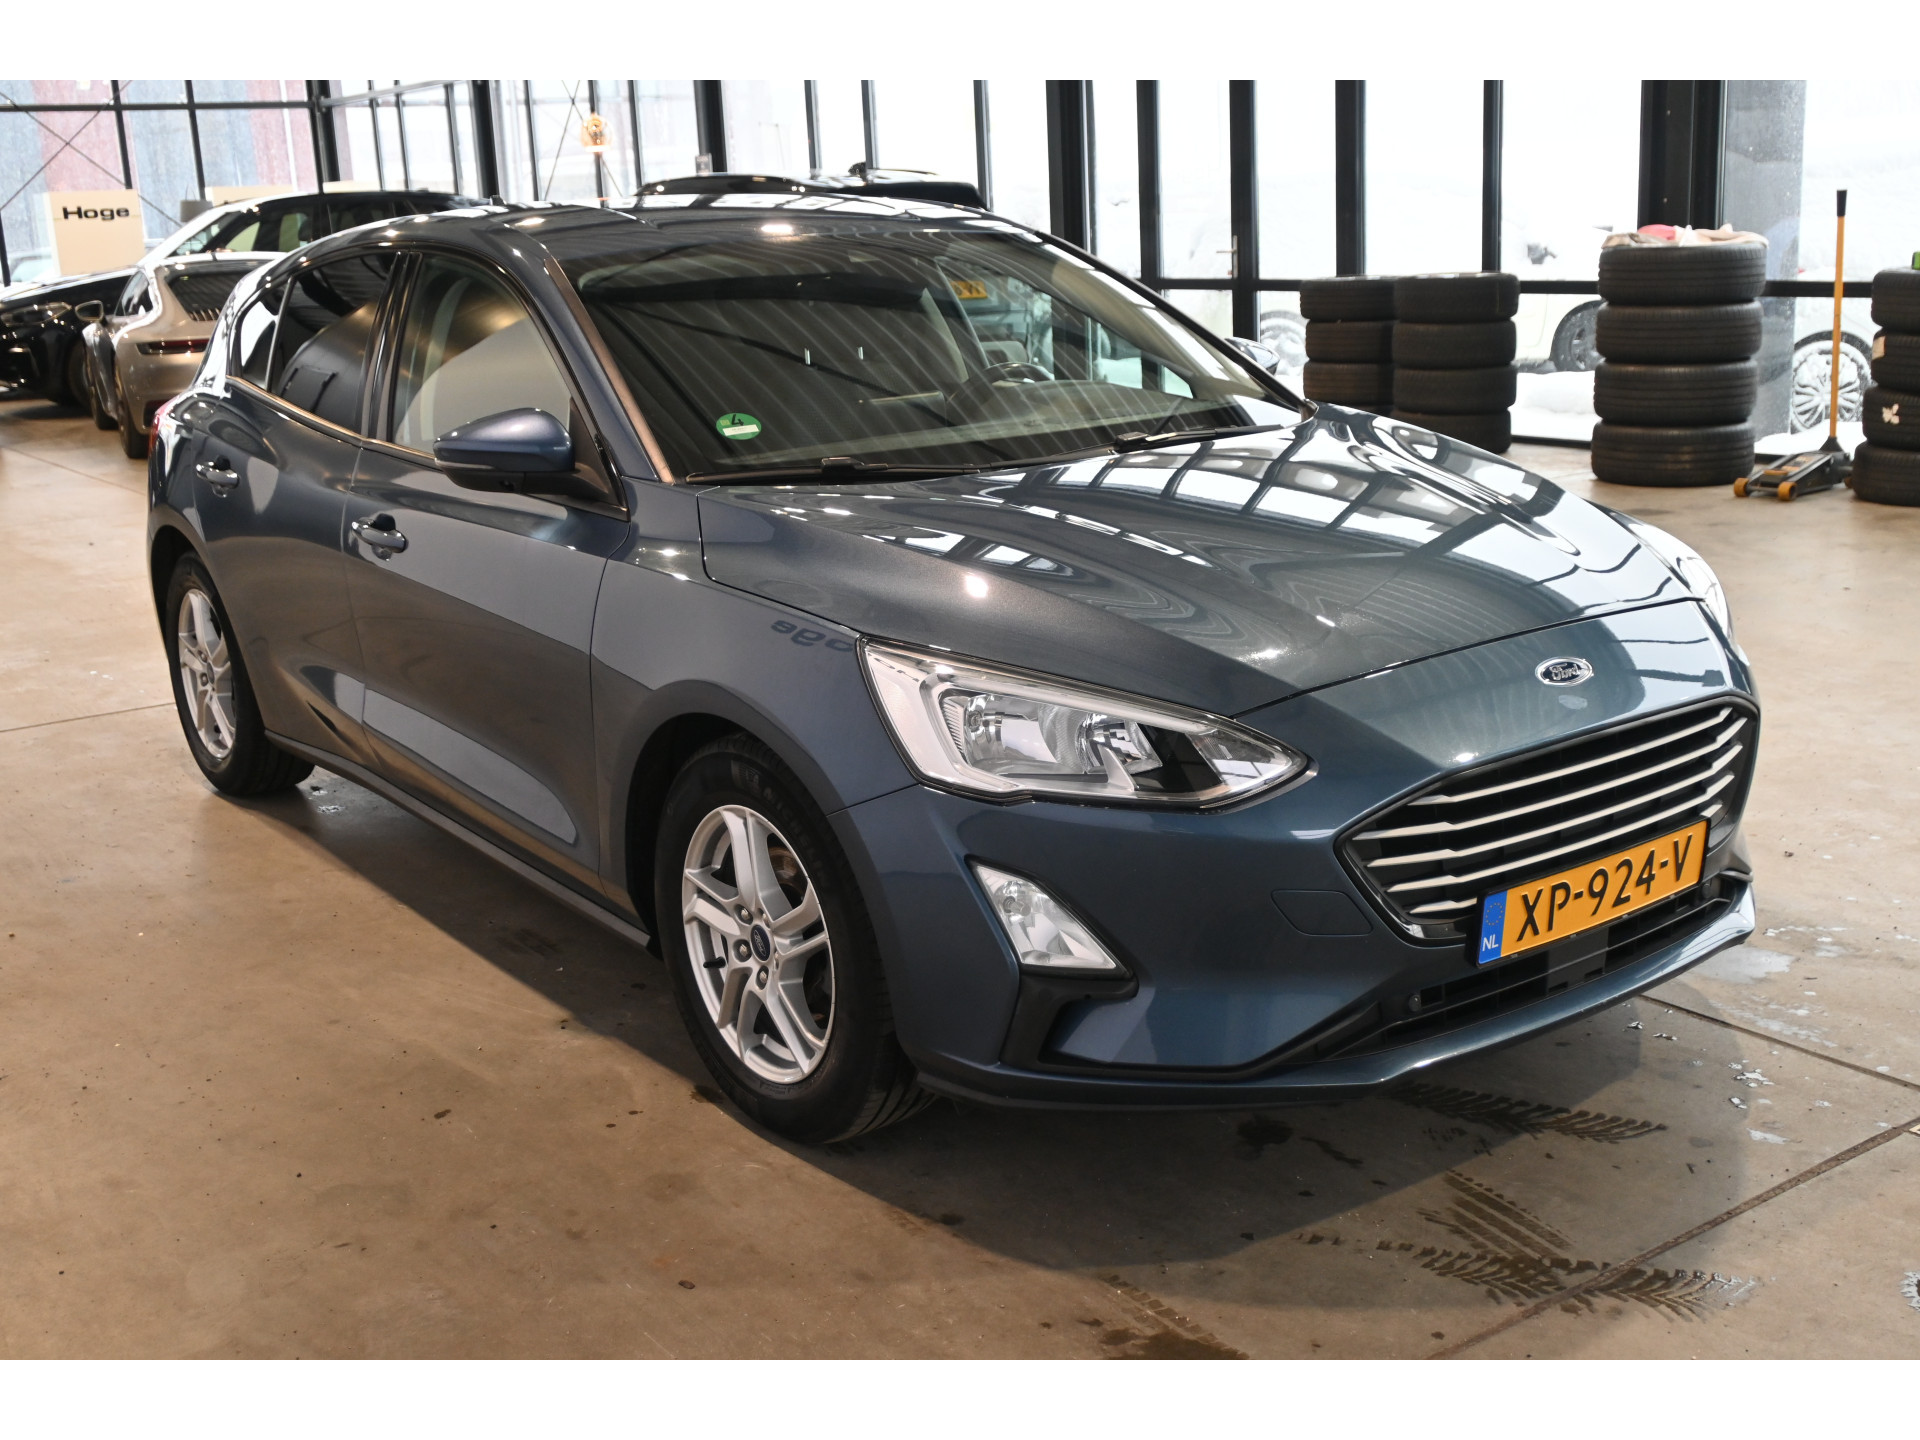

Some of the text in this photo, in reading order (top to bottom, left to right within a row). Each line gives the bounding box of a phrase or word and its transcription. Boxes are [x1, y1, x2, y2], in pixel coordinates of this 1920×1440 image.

[62, 206, 130, 221] Hoge
[731, 413, 744, 426] 4
[1549, 662, 1580, 681] Ford
[1516, 833, 1692, 942] XP-924-V
[1482, 934, 1499, 952] NL
